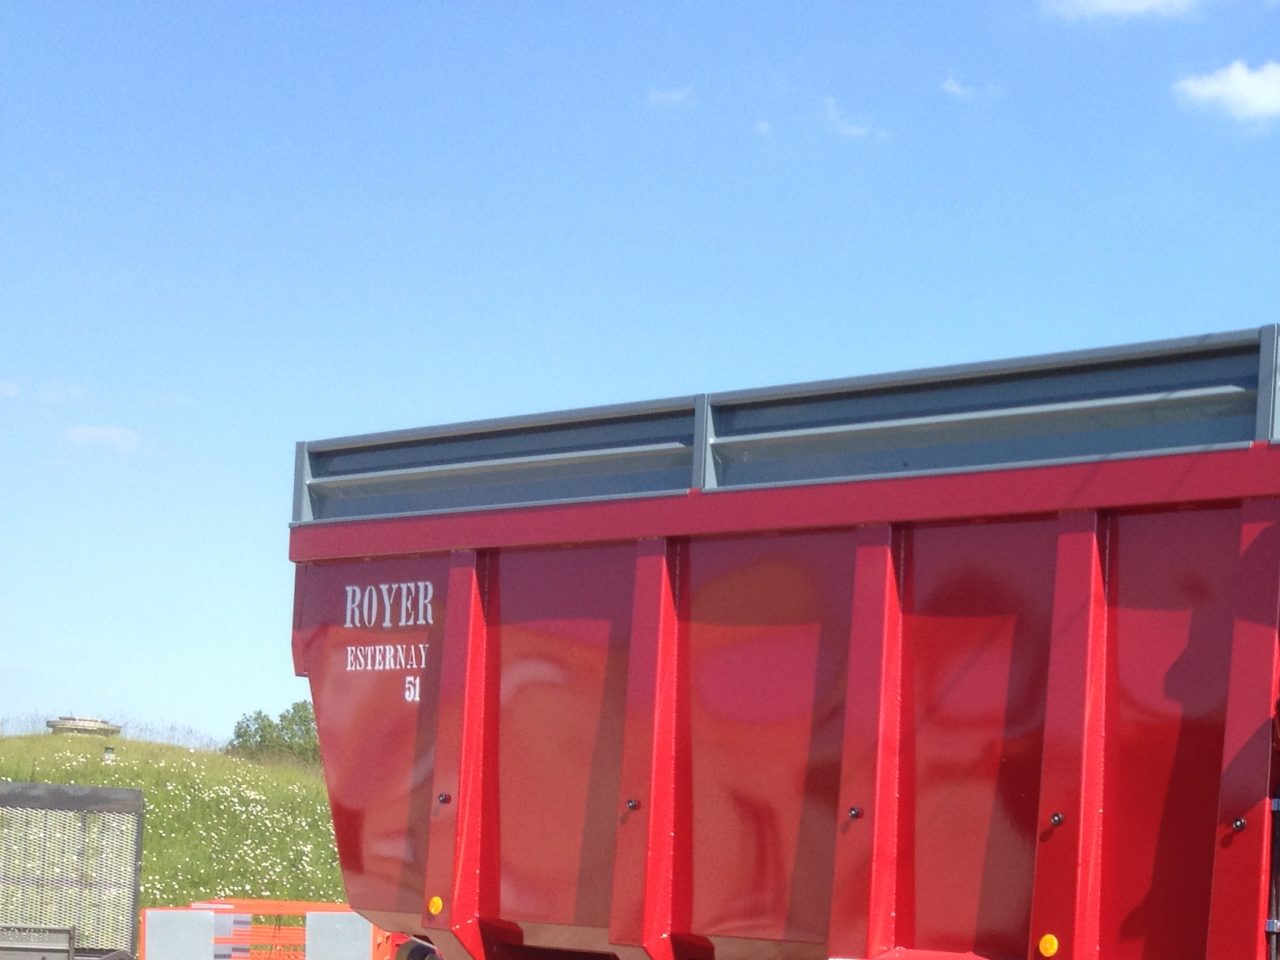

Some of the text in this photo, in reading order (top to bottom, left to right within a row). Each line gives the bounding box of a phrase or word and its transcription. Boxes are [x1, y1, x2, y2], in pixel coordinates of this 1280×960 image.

[343, 581, 434, 628] ROYER
[346, 644, 429, 671] ESTERNAY
[404, 676, 420, 702] 51
